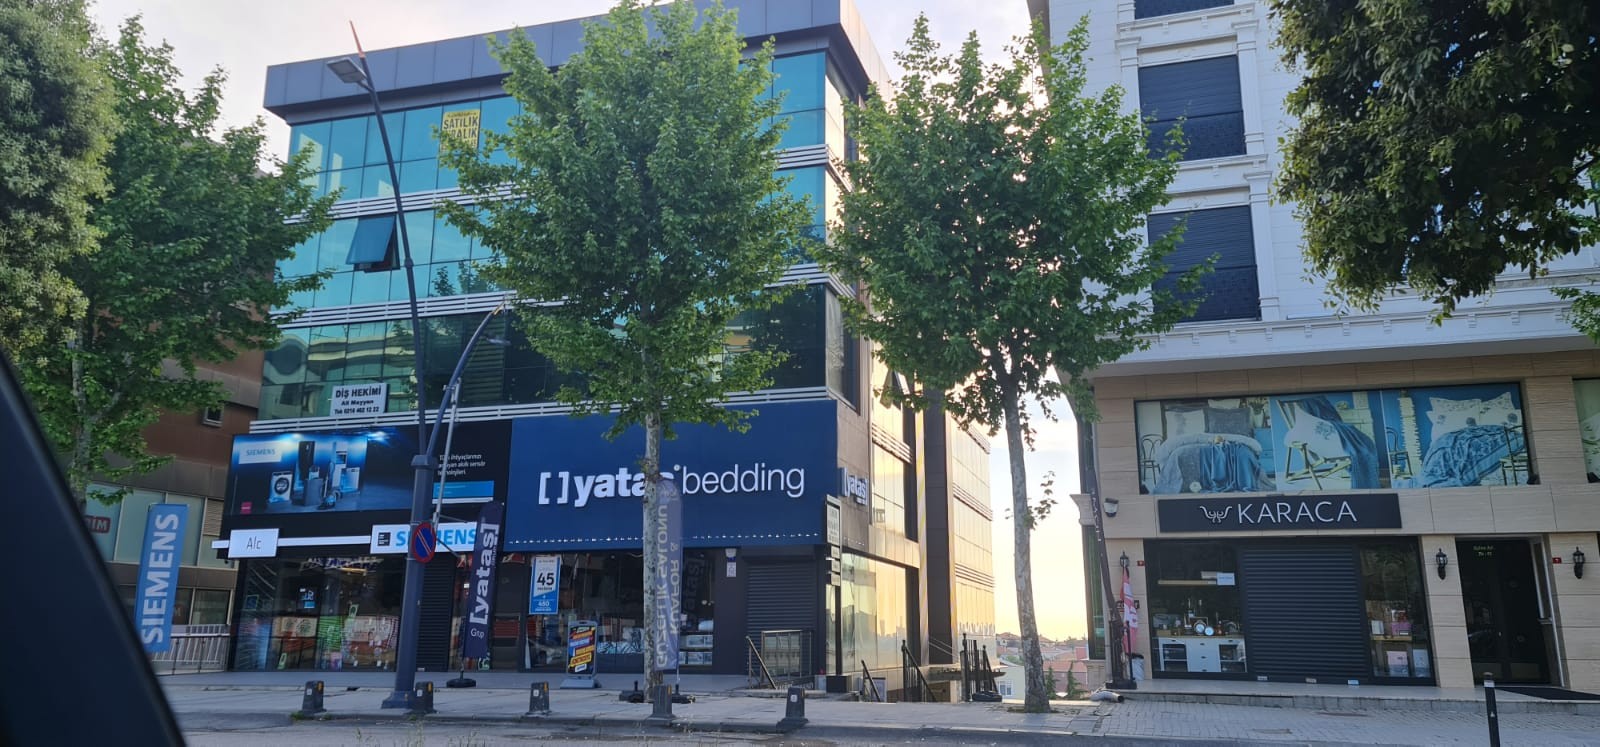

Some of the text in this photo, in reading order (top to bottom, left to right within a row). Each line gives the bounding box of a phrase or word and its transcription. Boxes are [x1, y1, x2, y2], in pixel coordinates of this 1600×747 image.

[335, 384, 382, 399] DİŞ HEKİMİ
[246, 448, 276, 456] SIEMENS
[682, 463, 805, 498] bedding
[1237, 501, 1358, 524] KARACA
[141, 513, 179, 644] SIEMENS
[537, 573, 554, 586] 45
